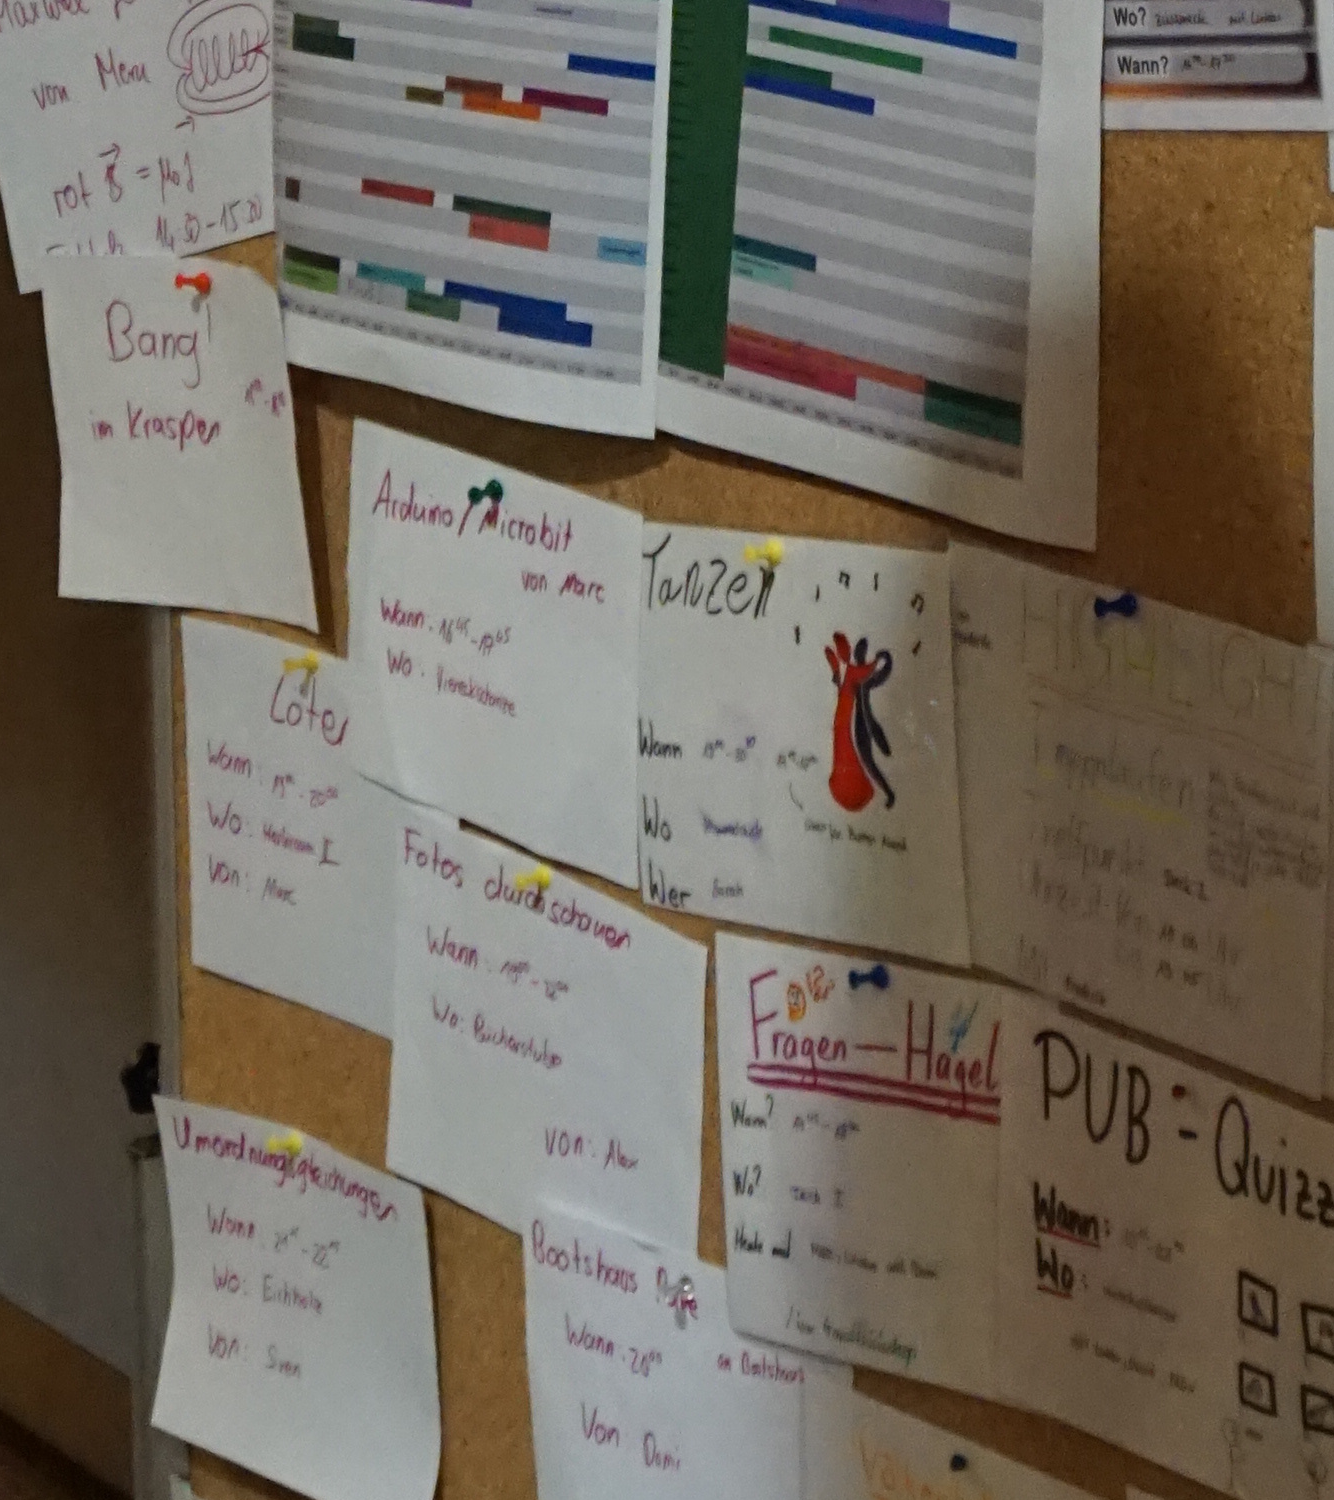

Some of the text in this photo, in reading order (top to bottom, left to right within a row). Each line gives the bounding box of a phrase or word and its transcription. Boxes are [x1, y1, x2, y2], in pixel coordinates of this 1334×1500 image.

[1114, 7, 1147, 29] Wo?
[1117, 54, 1170, 76] Wann?
[520, 568, 549, 593] von
[402, 827, 464, 891] Fotos
